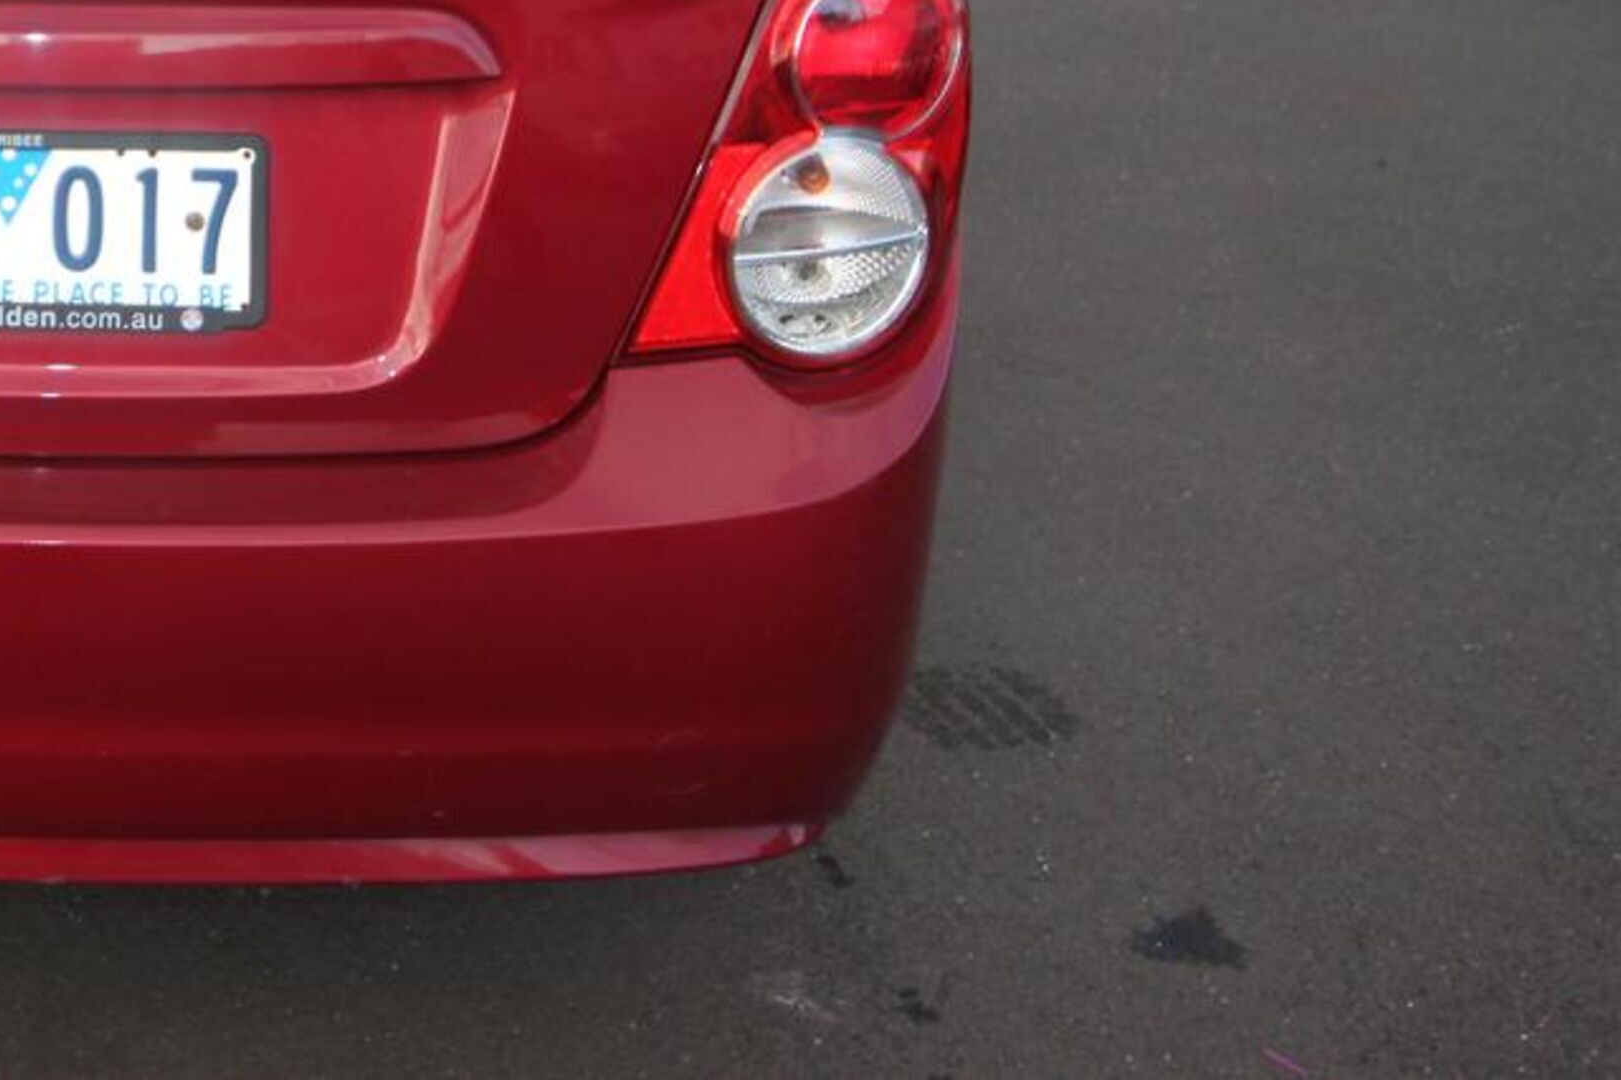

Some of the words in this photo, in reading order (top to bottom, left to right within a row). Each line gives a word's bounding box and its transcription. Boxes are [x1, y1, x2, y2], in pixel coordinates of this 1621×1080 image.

[52, 165, 238, 275] 017
[33, 280, 123, 306] PLACE
[142, 282, 179, 306] TO
[199, 284, 233, 309] BE
